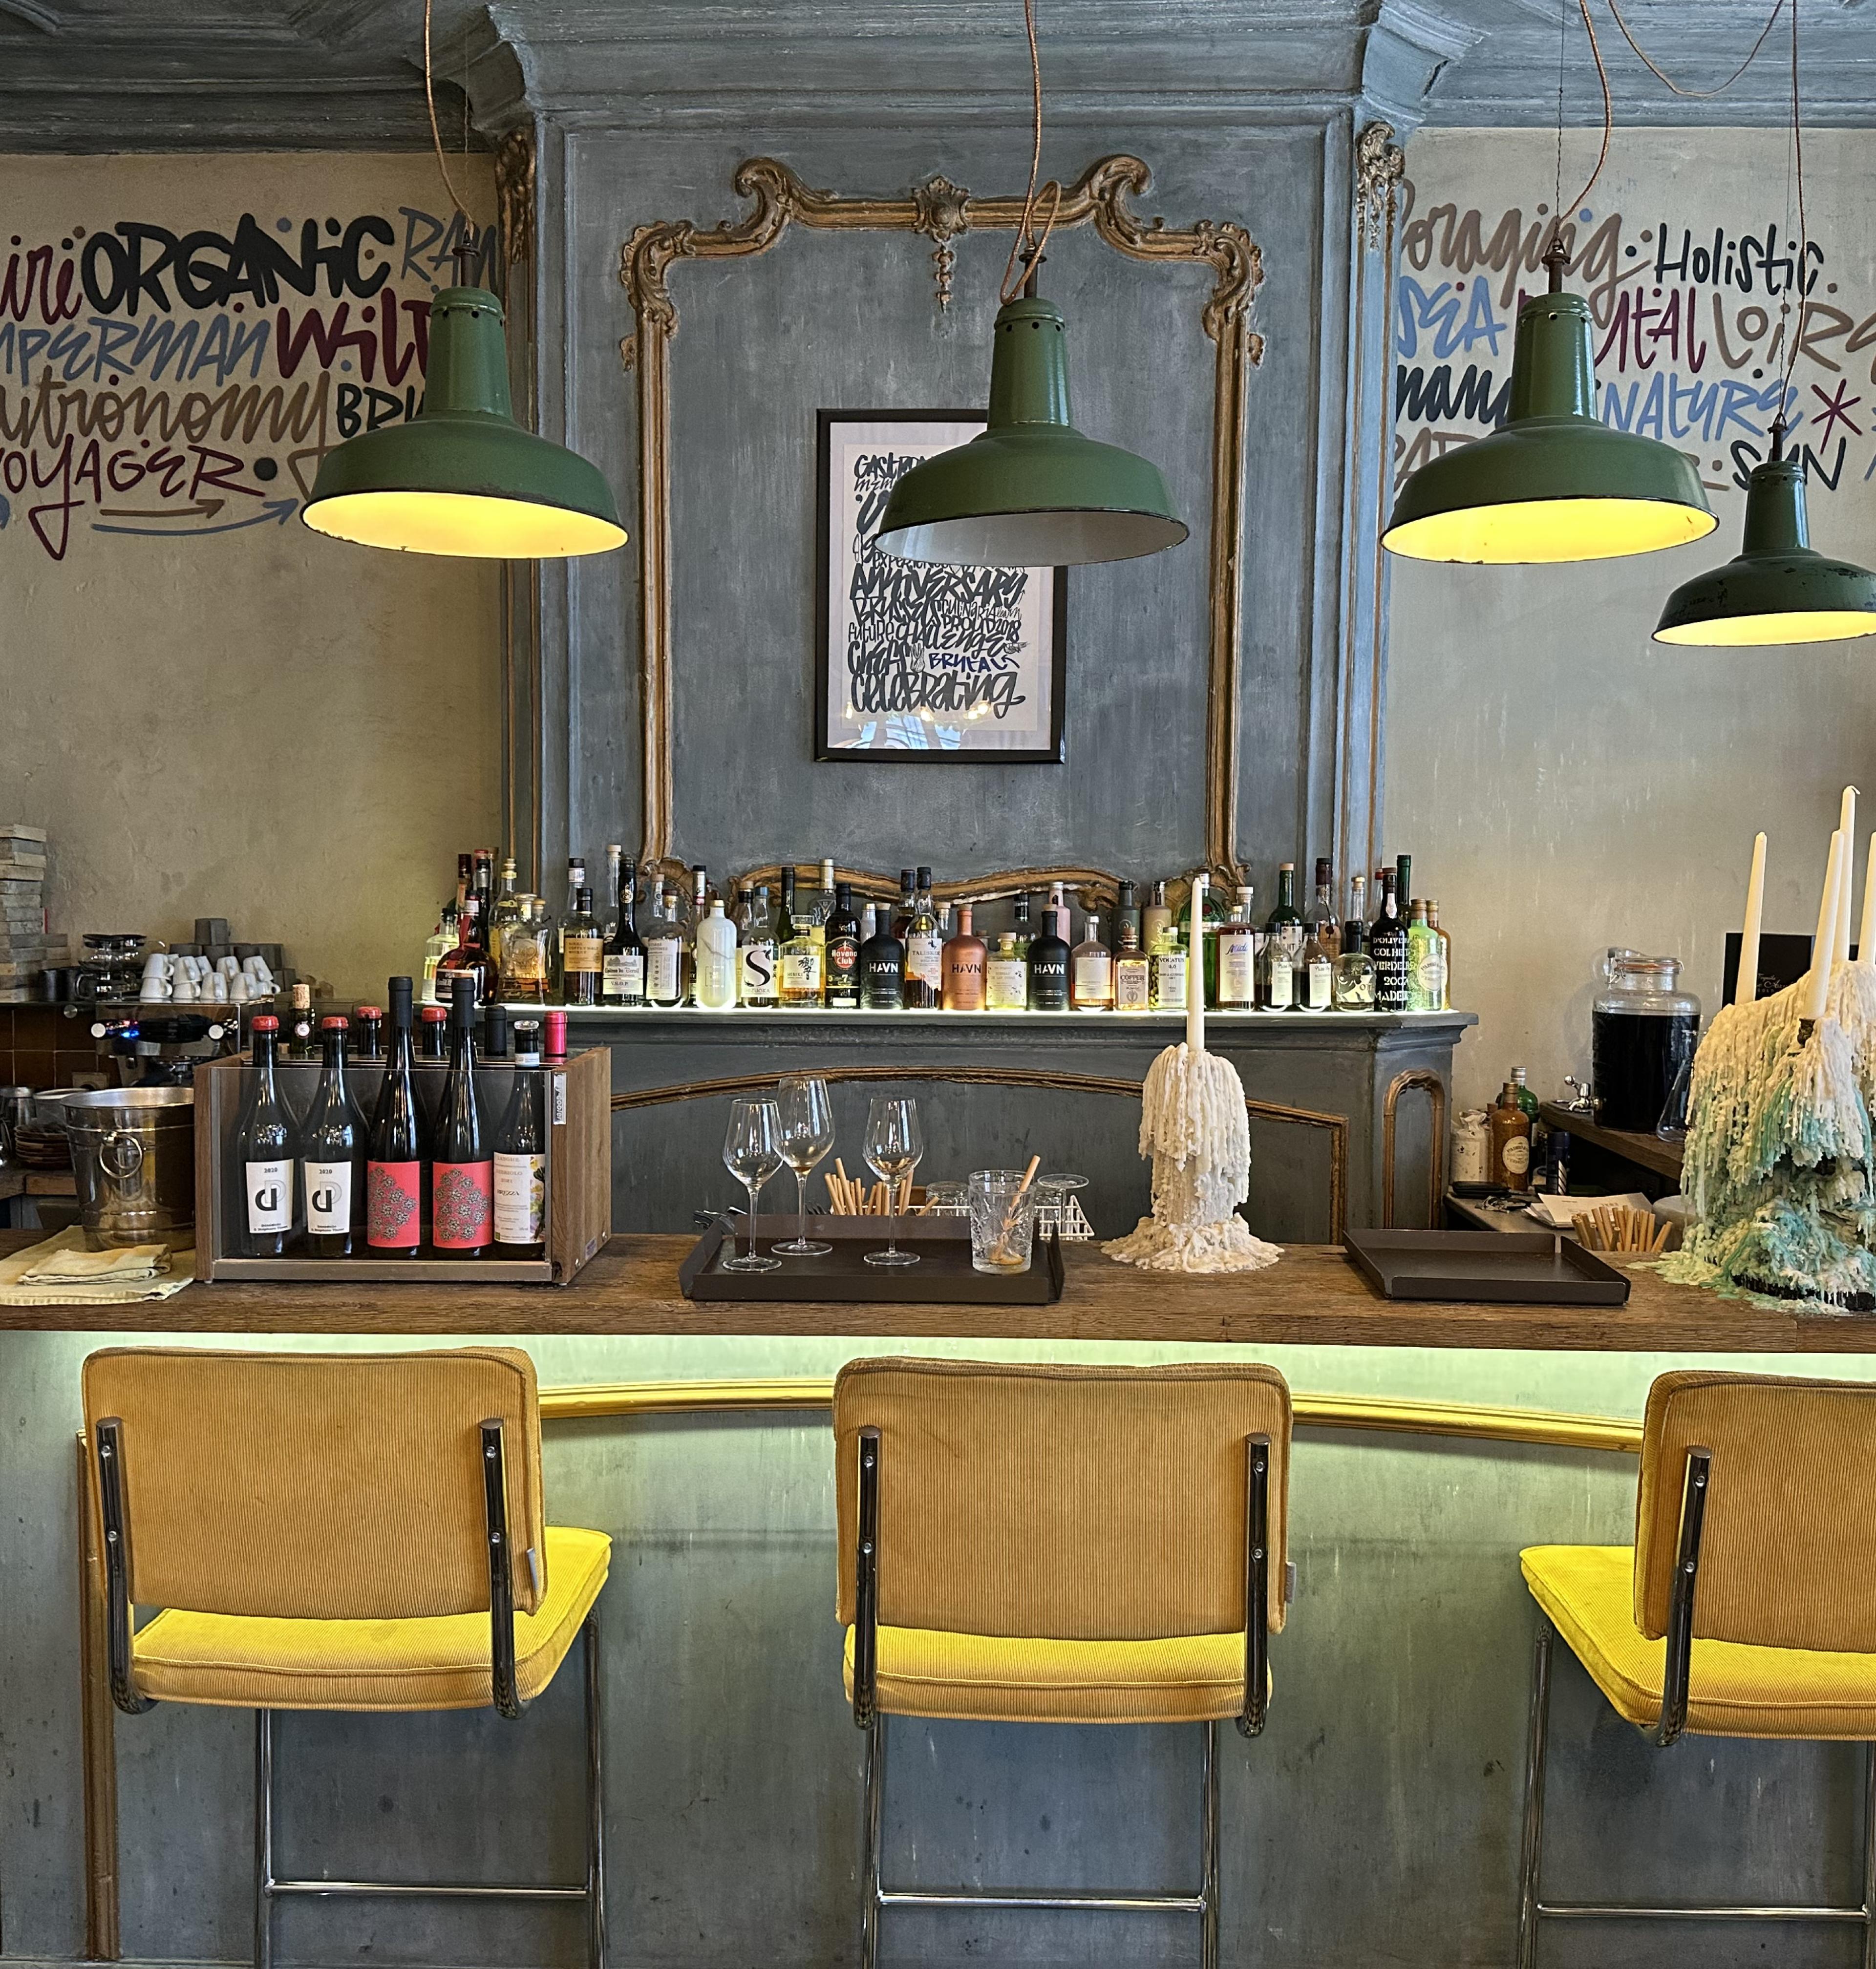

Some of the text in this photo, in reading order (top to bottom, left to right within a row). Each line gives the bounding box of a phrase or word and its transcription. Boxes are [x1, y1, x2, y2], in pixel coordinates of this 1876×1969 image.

[1400, 178, 1652, 330] oraging
[0, 434, 265, 560] OYAGER
[869, 962, 898, 973] HAVN
[952, 964, 981, 974] HAVN
[1034, 964, 1065, 974] HAVN
[841, 974, 849, 983] 7
